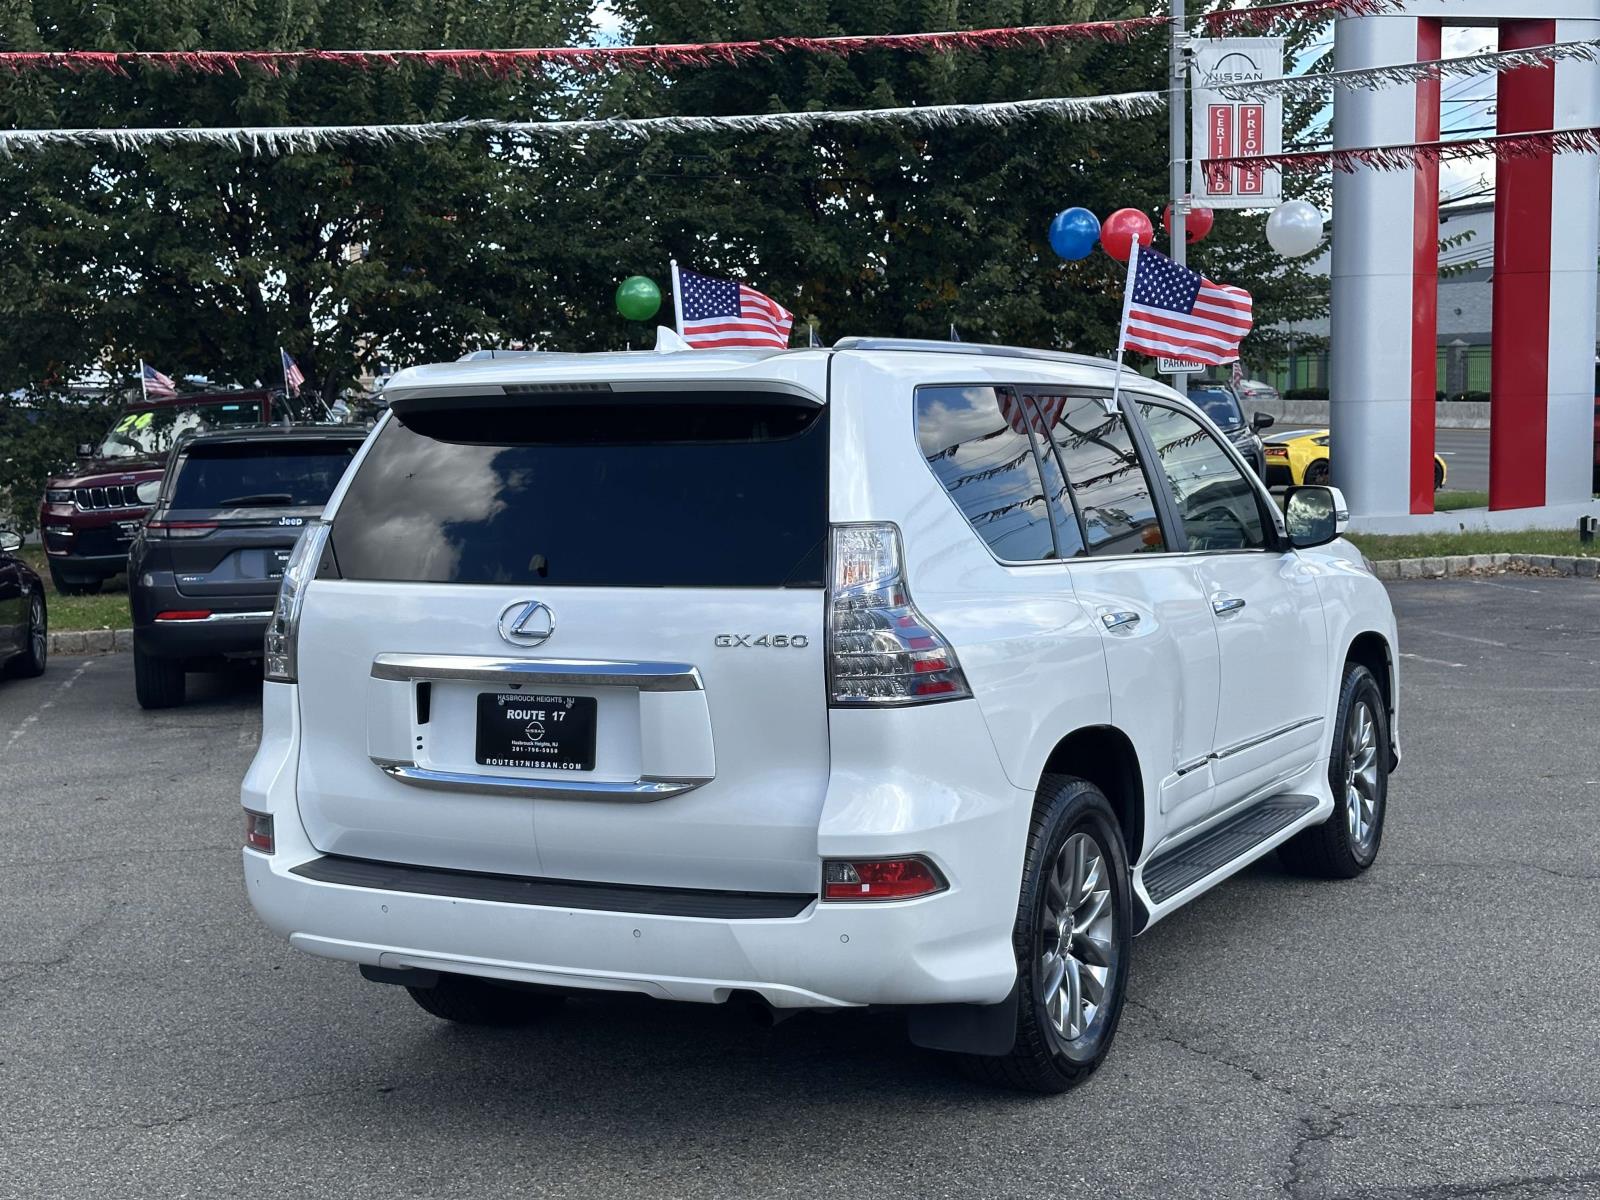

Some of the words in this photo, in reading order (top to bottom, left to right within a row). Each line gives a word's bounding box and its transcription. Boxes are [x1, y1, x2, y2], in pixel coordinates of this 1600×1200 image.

[1208, 72, 1263, 81] NISSAN
[1243, 109, 1258, 191] PREOWED
[279, 516, 303, 526] Jeep
[714, 633, 809, 648] GX460
[497, 694, 535, 703] HASBROUCK
[506, 709, 546, 721] ROUTE
[552, 711, 566, 721] 17
[486, 758, 581, 770] ROUTE17NISSAN.COM
